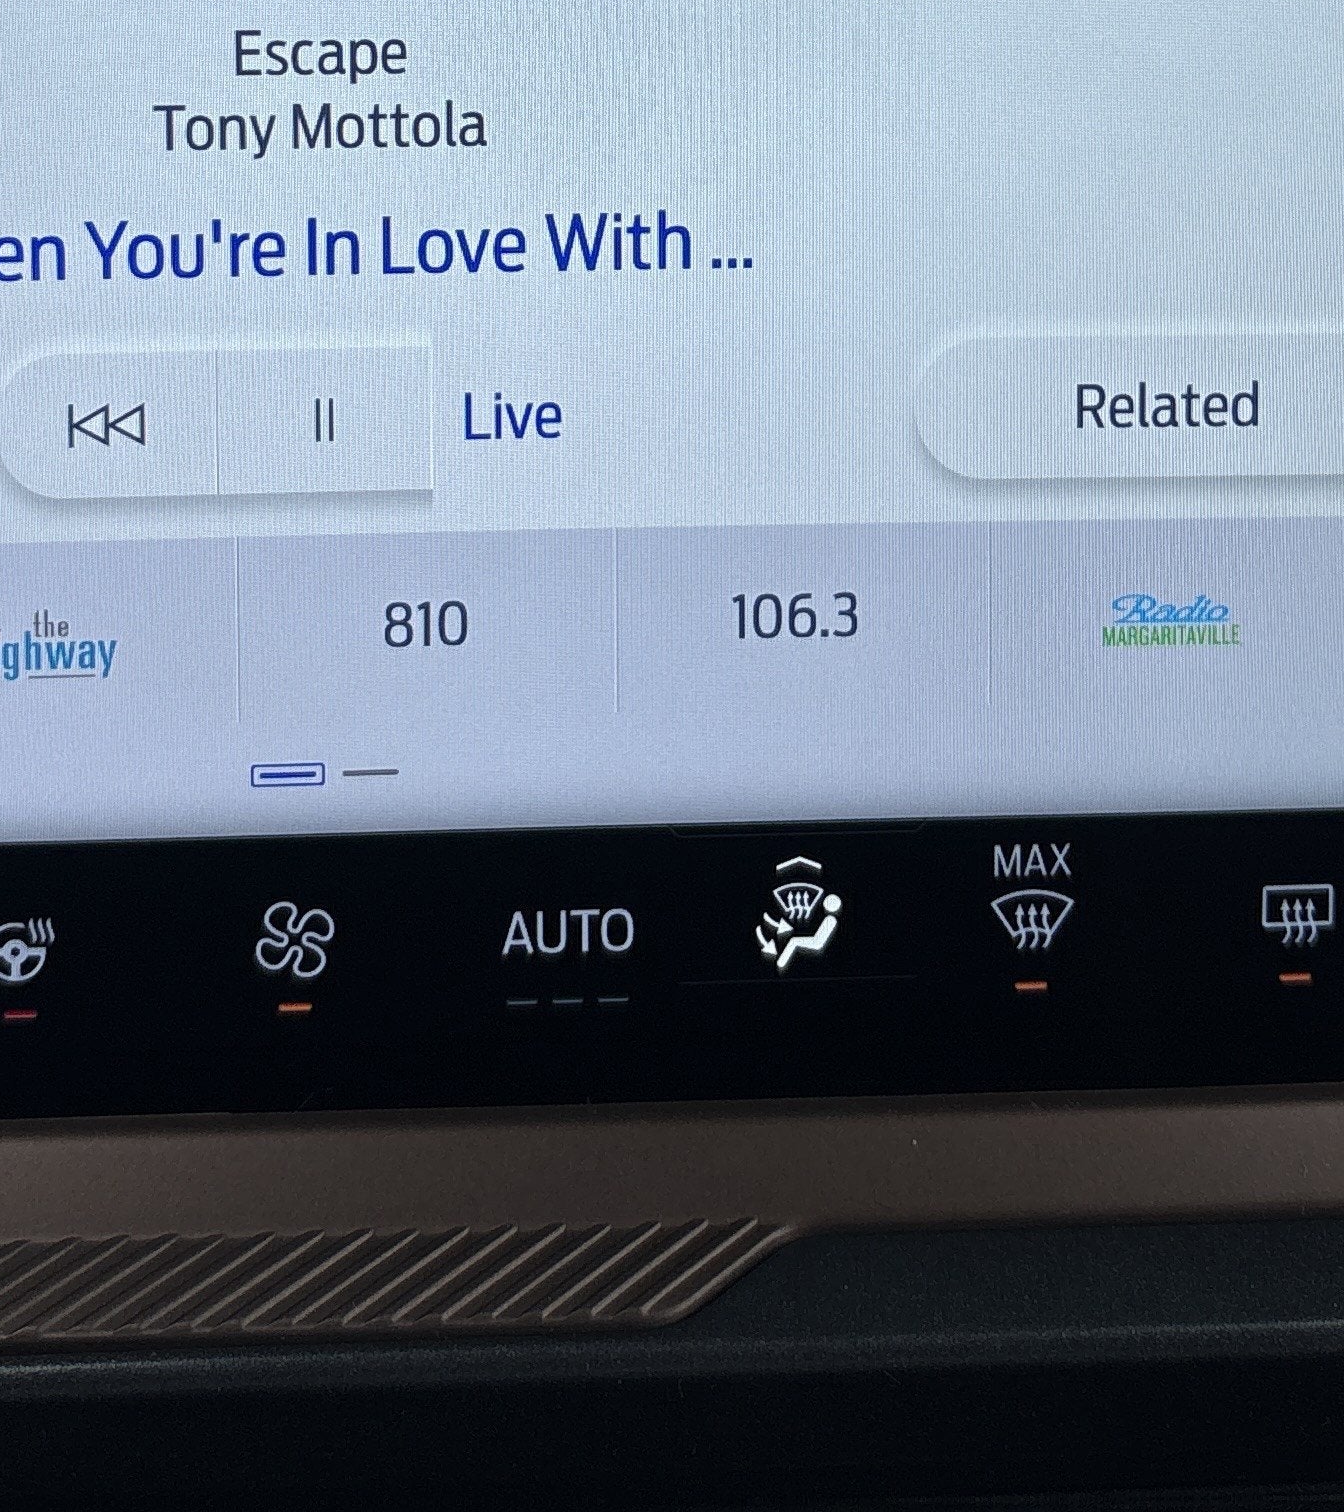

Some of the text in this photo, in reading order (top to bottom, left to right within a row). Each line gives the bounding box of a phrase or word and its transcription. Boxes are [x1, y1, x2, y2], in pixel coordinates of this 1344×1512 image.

[235, 29, 407, 85] Escape
[152, 99, 488, 160] Tony Mottola
[84, 218, 286, 280] You're
[307, 217, 360, 276] In
[382, 216, 526, 275] Love
[544, 209, 691, 272] With
[464, 392, 562, 441] Live
[1076, 380, 1259, 429] Related
[32, 609, 69, 638] the
[384, 600, 468, 648] 810
[732, 591, 858, 639] 106.3
[1112, 594, 1230, 623] Radio
[1102, 625, 1240, 647] MARGARITAVILLE
[993, 843, 1071, 877] MAX
[502, 908, 634, 955] AUTO
